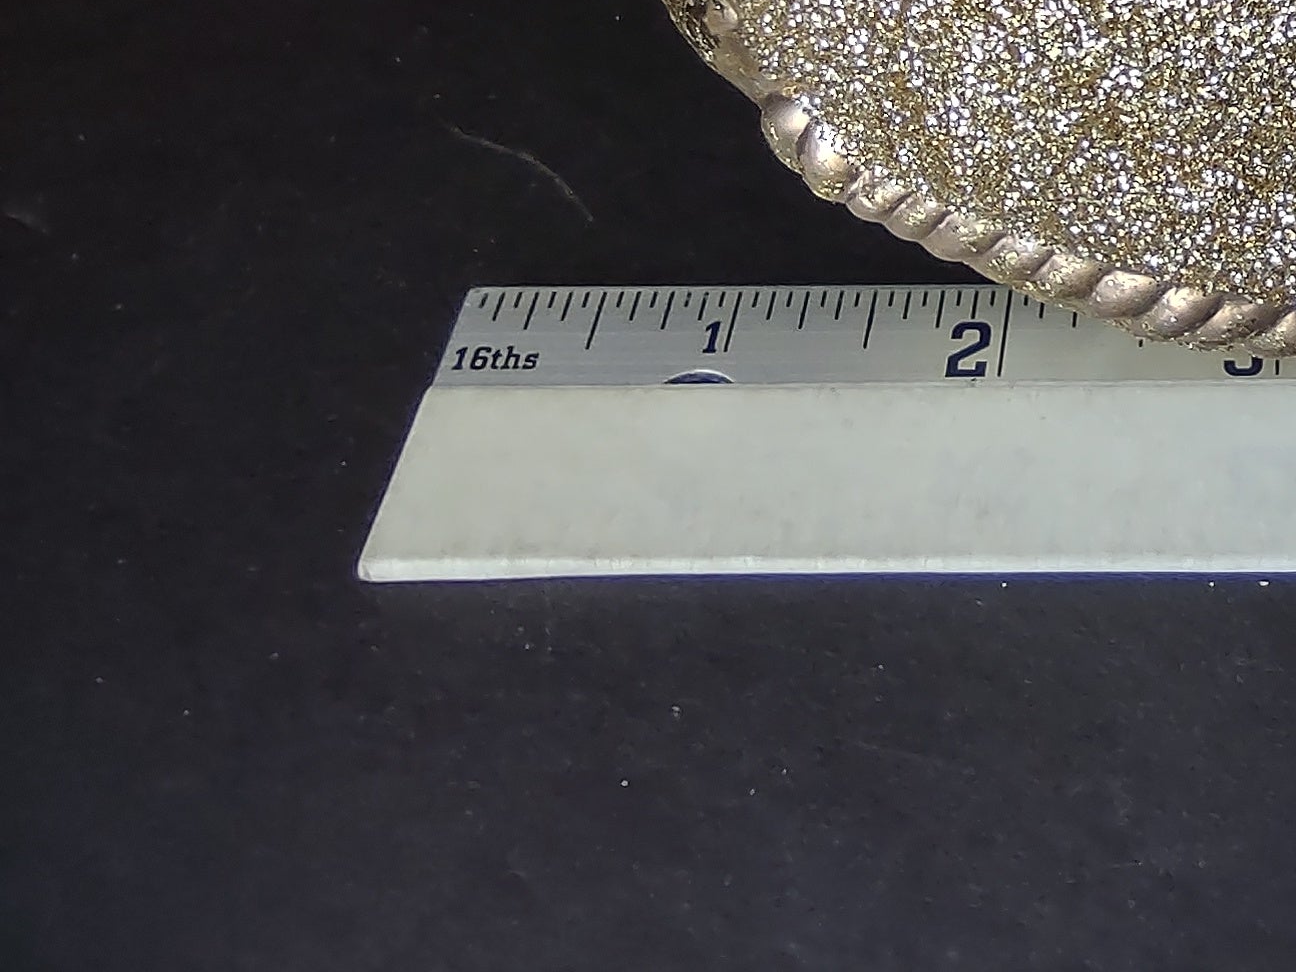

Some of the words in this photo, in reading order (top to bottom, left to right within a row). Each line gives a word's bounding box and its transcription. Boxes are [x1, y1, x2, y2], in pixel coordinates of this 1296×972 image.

[451, 346, 539, 370] 16ths
[702, 321, 720, 354] 1
[944, 321, 991, 377] 2
